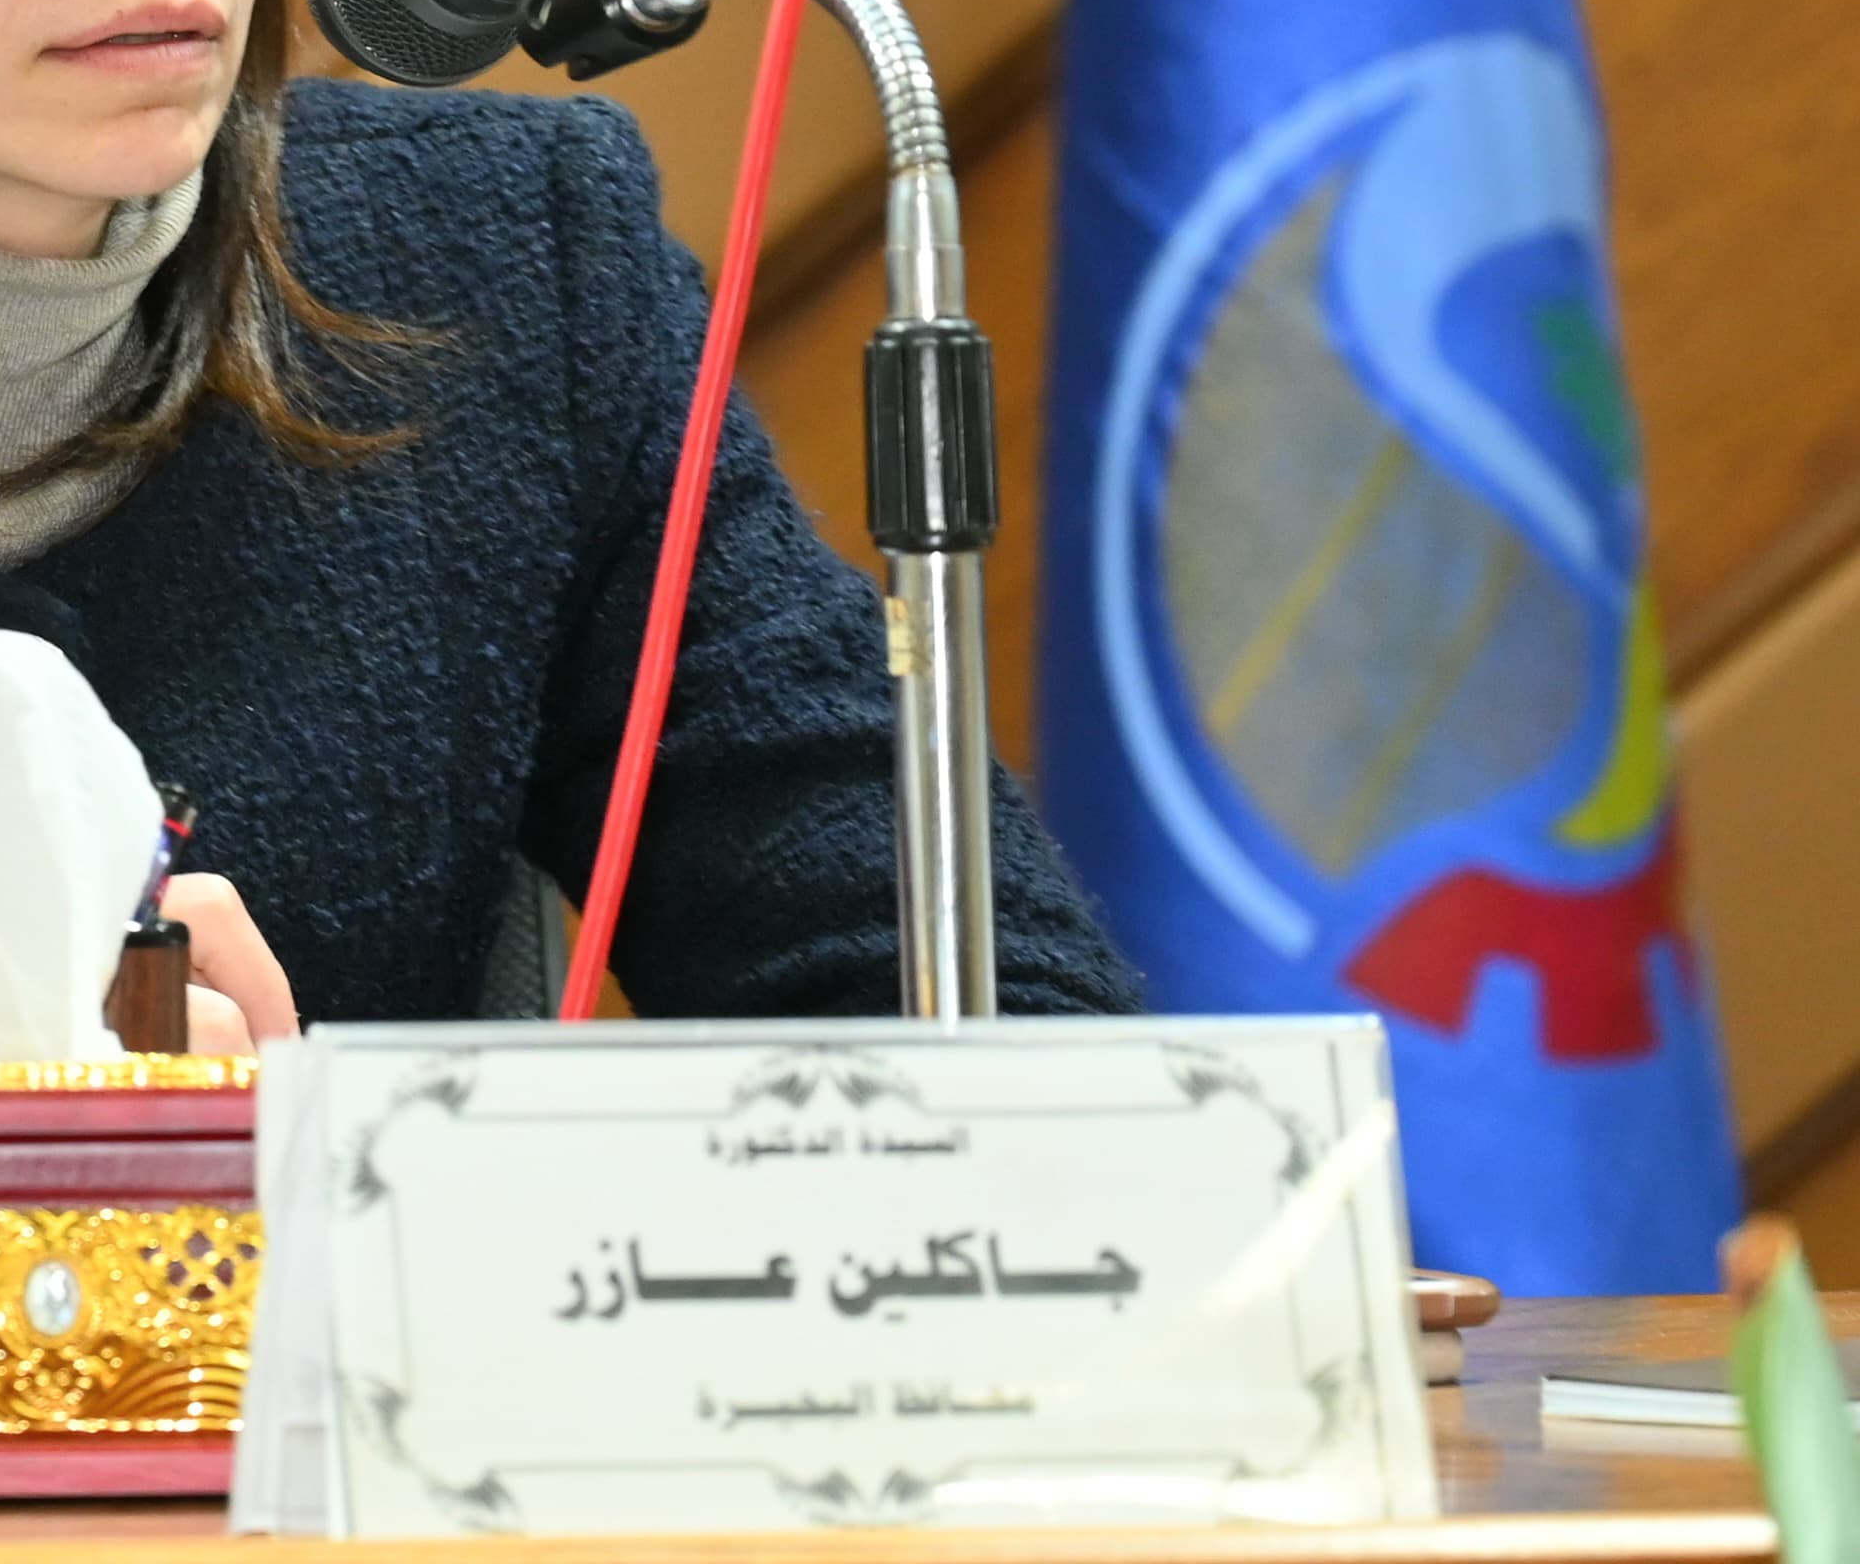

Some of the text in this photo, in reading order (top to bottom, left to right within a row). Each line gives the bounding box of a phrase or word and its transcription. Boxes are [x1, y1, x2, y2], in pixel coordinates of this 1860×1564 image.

[859, 1123, 970, 1163] السيدة
[554, 1230, 1142, 1324] جاكلين عازر
